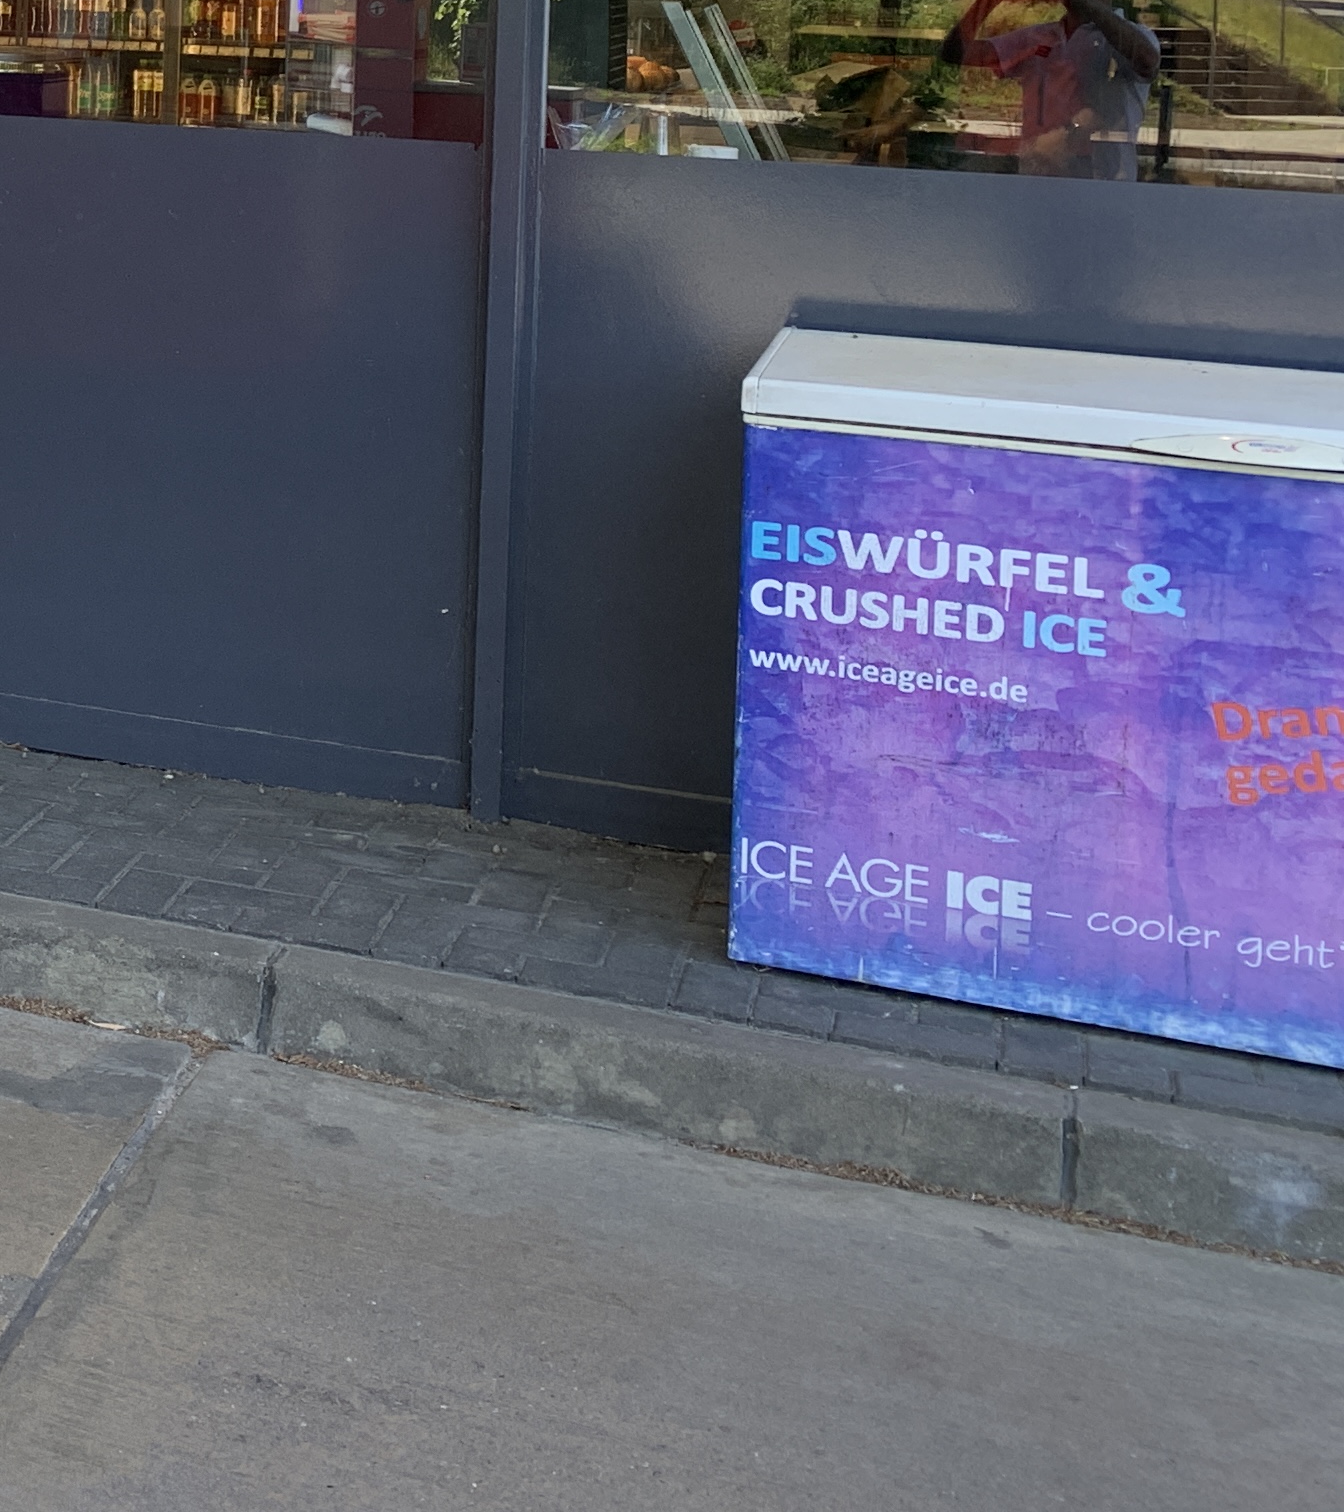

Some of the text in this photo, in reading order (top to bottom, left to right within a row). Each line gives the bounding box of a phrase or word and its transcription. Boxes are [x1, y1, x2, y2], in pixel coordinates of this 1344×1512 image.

[750, 521, 1187, 618] EISWÜRFEL &
[749, 578, 1108, 658] CRUSHED ICE
[749, 648, 1029, 704] www.iceageice.de
[740, 836, 814, 885] ICE
[825, 852, 930, 904] AGE
[946, 869, 1033, 921] ICE
[1087, 910, 1221, 950] cooler
